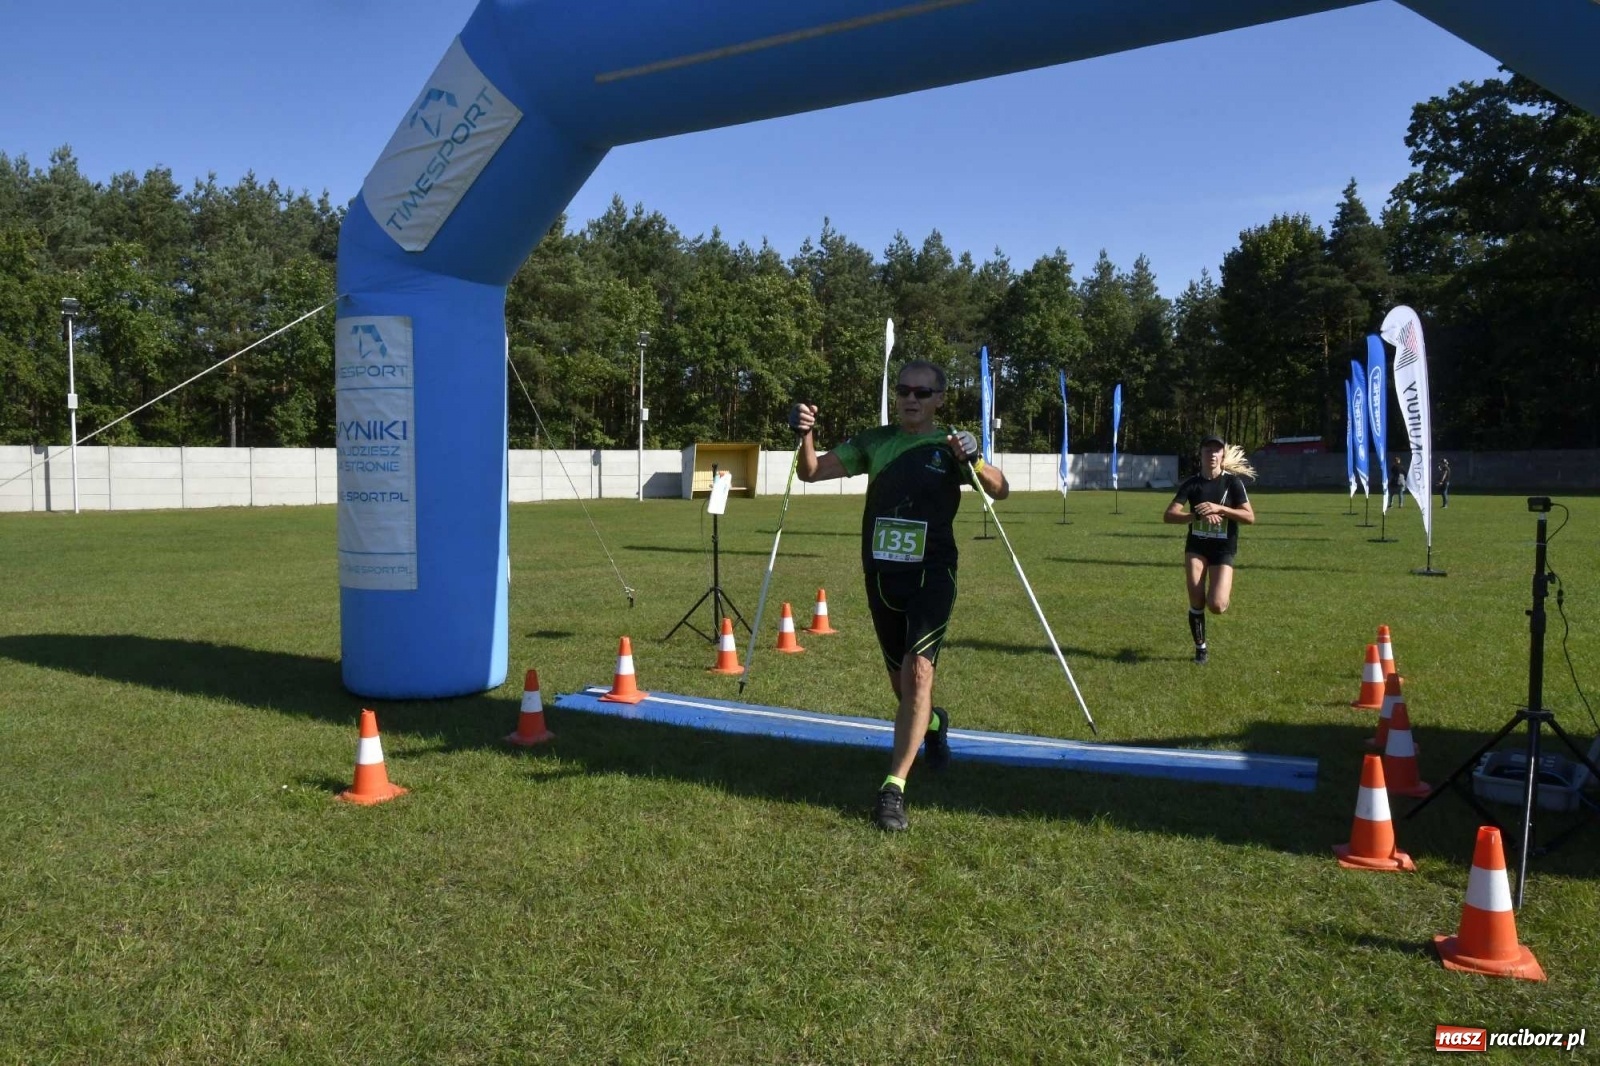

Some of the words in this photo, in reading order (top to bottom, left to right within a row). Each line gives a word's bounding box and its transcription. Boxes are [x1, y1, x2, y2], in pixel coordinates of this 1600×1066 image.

[386, 86, 493, 230] TIMESPORT
[345, 461, 400, 472] STRONIE
[878, 529, 917, 552] 135
